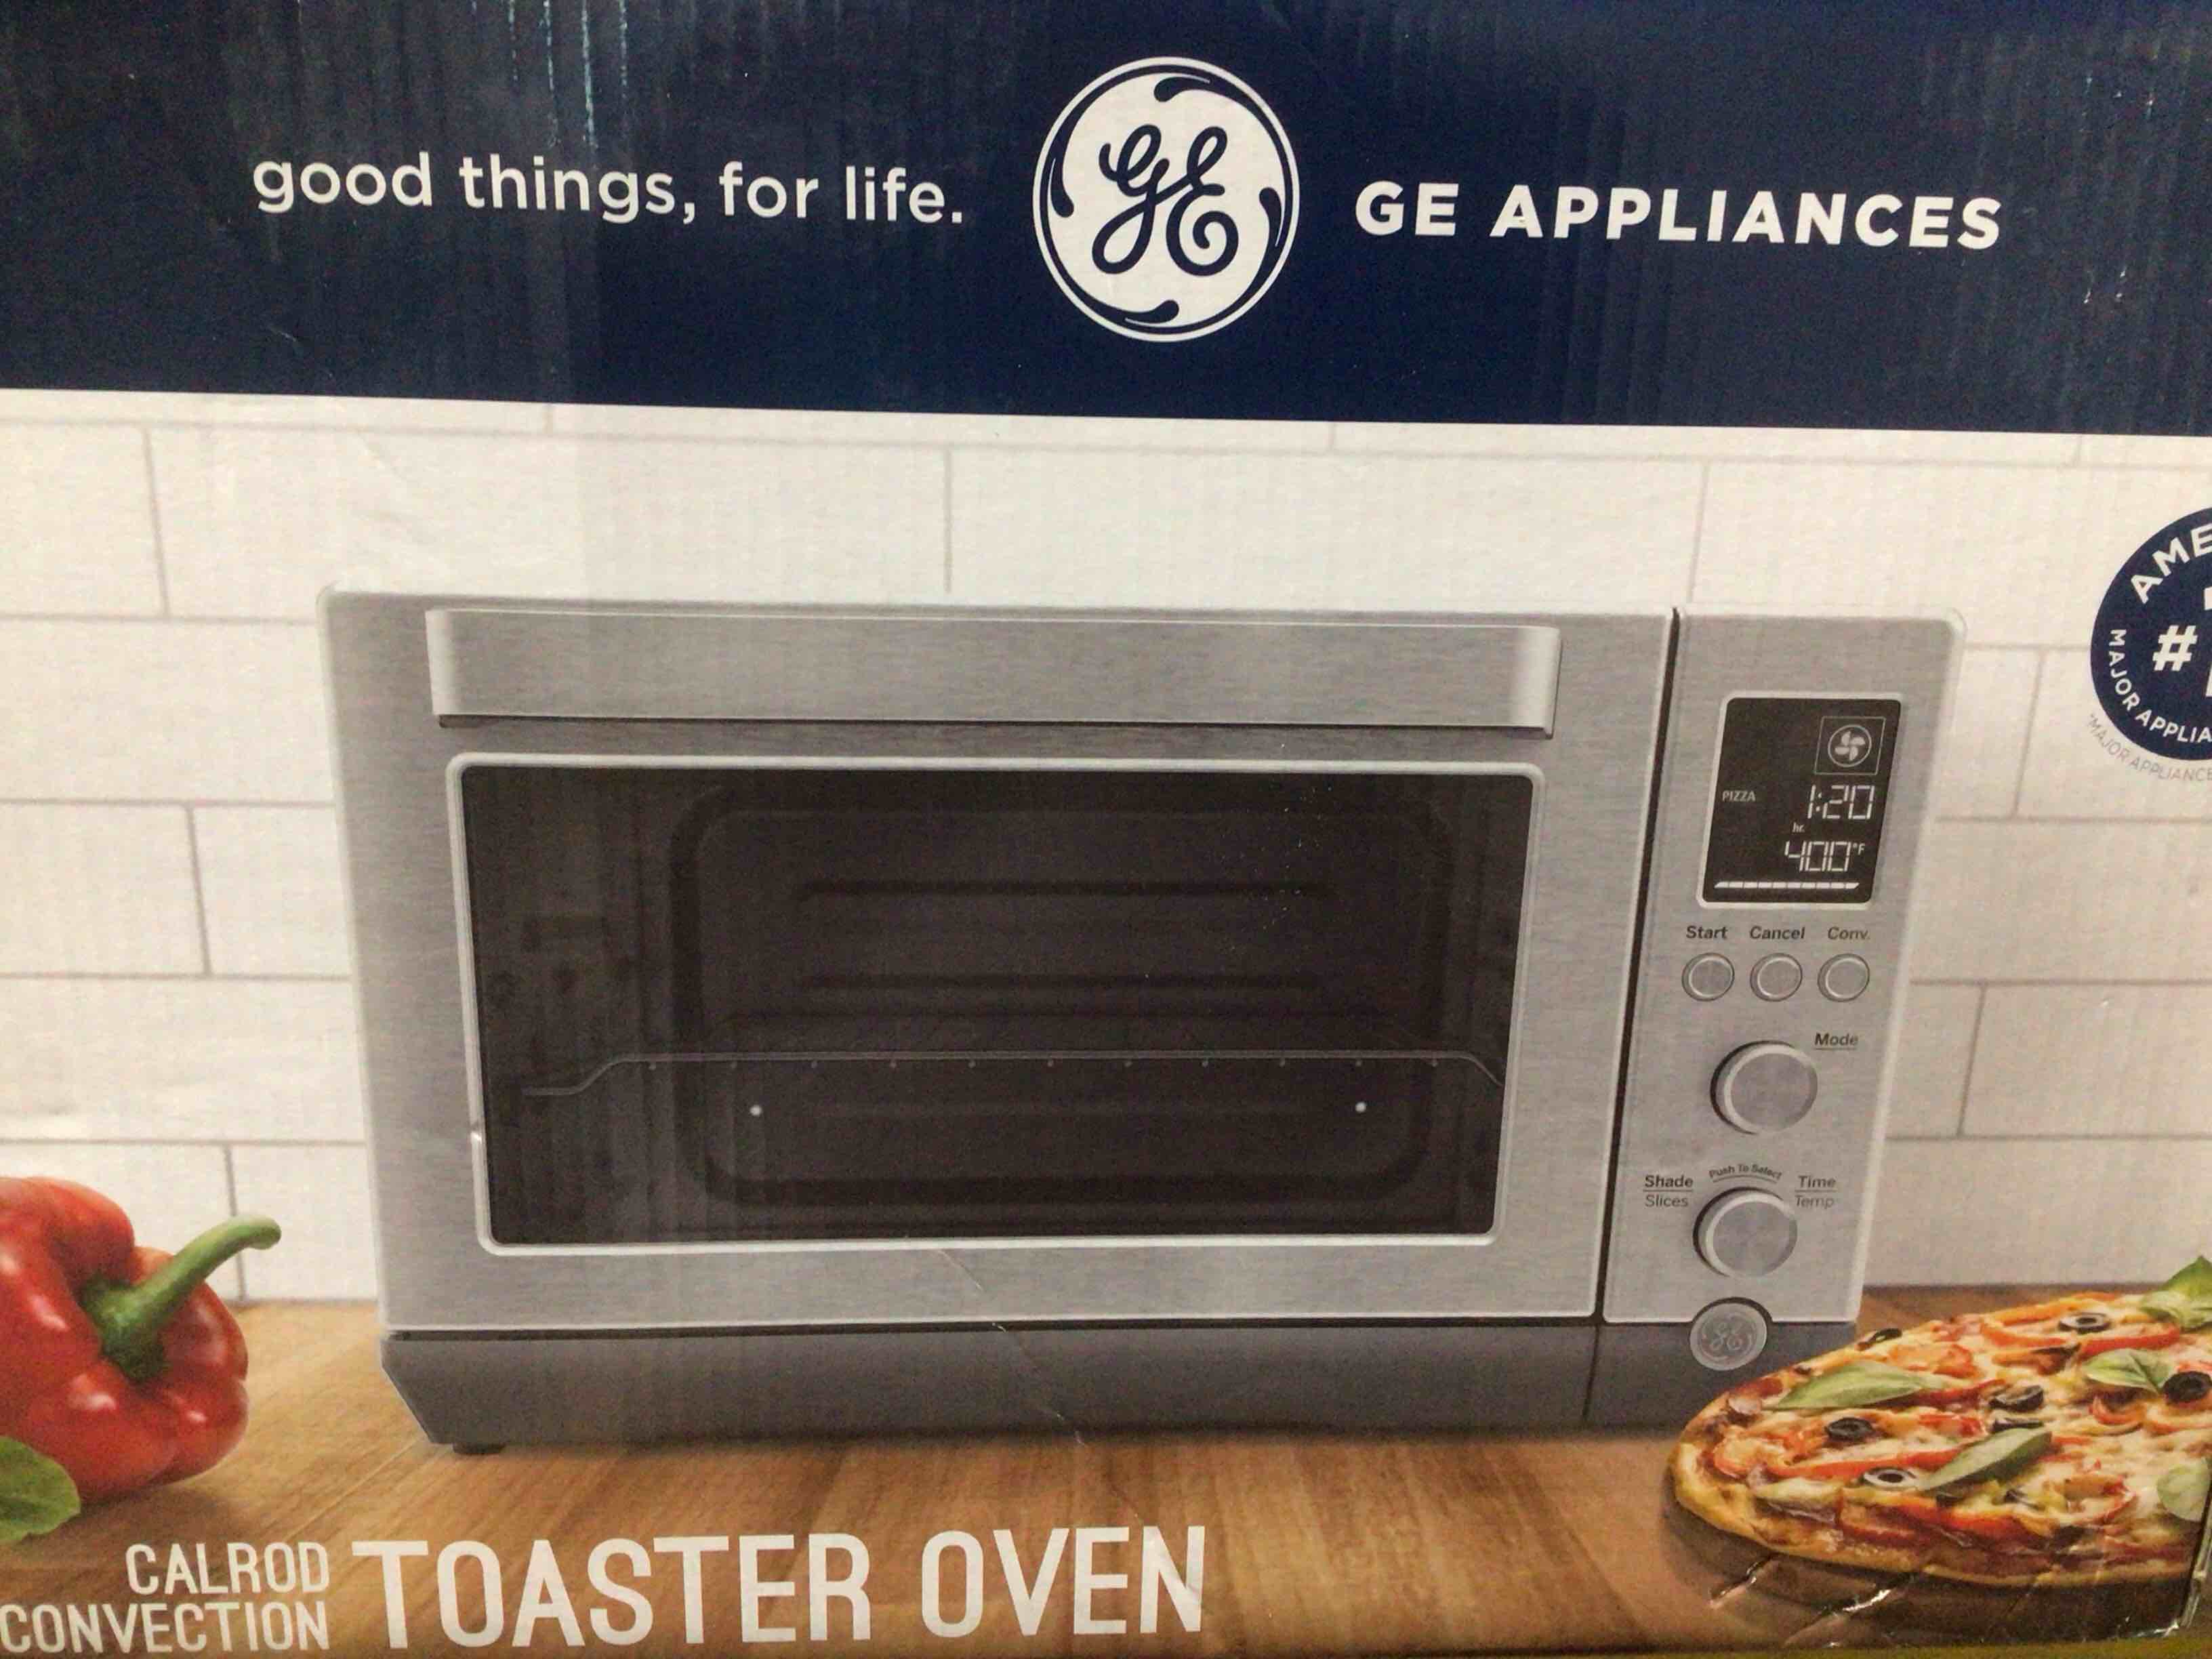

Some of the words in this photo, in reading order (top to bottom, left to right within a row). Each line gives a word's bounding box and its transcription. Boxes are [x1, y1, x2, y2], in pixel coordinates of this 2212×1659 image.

[253, 151, 432, 213] good
[459, 153, 695, 224] things,
[718, 161, 819, 218] for
[846, 165, 962, 224] life.
[1355, 180, 1459, 237] GE
[1490, 184, 2002, 251] APPLIANCES
[2108, 629, 2141, 711] MAJOR
[1722, 790, 1756, 802] PIZZA
[1807, 784, 1875, 820] 1:20
[1685, 925, 1728, 940] Start
[1749, 925, 1805, 940] Cancel
[1814, 1032, 1858, 1046] Mode
[1644, 1174, 1694, 1189] Shade
[1708, 1165, 1736, 1178] Push
[1798, 1175, 1837, 1189] Time
[1645, 1193, 1689, 1208] Slices
[1795, 1194, 1835, 1210] Temp
[125, 1540, 330, 1595] CALROD
[351, 1533, 871, 1649] TOASTER
[922, 1525, 1206, 1638] OVEN
[0, 1600, 330, 1653] CONVECTION
